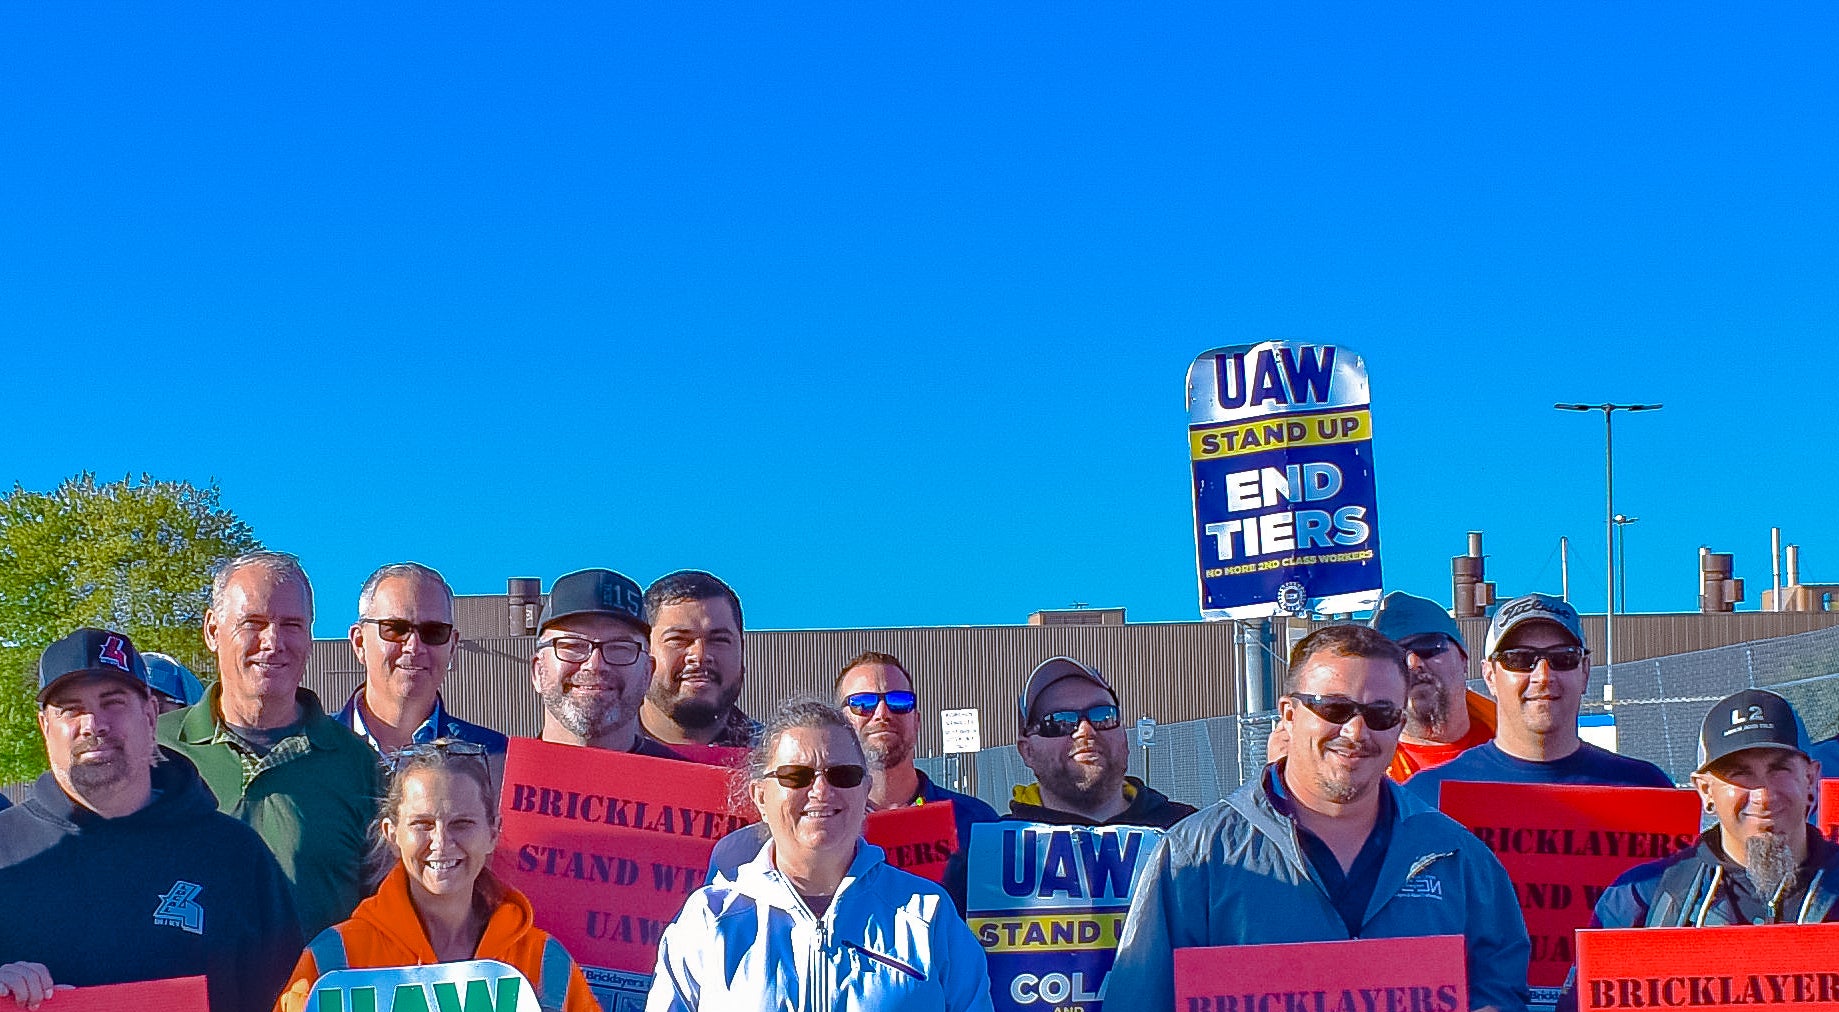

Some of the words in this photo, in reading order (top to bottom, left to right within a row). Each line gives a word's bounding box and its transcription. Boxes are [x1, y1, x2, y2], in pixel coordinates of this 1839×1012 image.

[1215, 346, 1336, 409] UAW
[1201, 423, 1306, 454] STAND
[1318, 418, 1359, 438] UP
[1226, 463, 1343, 512] END
[1206, 506, 1369, 560] TIERS
[1206, 567, 1222, 578] NO
[1225, 563, 1255, 575] MORE
[1258, 558, 1280, 571] 2ND
[1282, 554, 1316, 567] CLASS
[1319, 550, 1372, 563] WORKERS
[614, 585, 639, 616] 15
[1475, 827, 1695, 858] RICKLAYERS
[517, 844, 640, 887] STAND
[1002, 829, 1143, 899] UAW
[979, 920, 1101, 948] STAND
[1010, 972, 1108, 1004] COL
